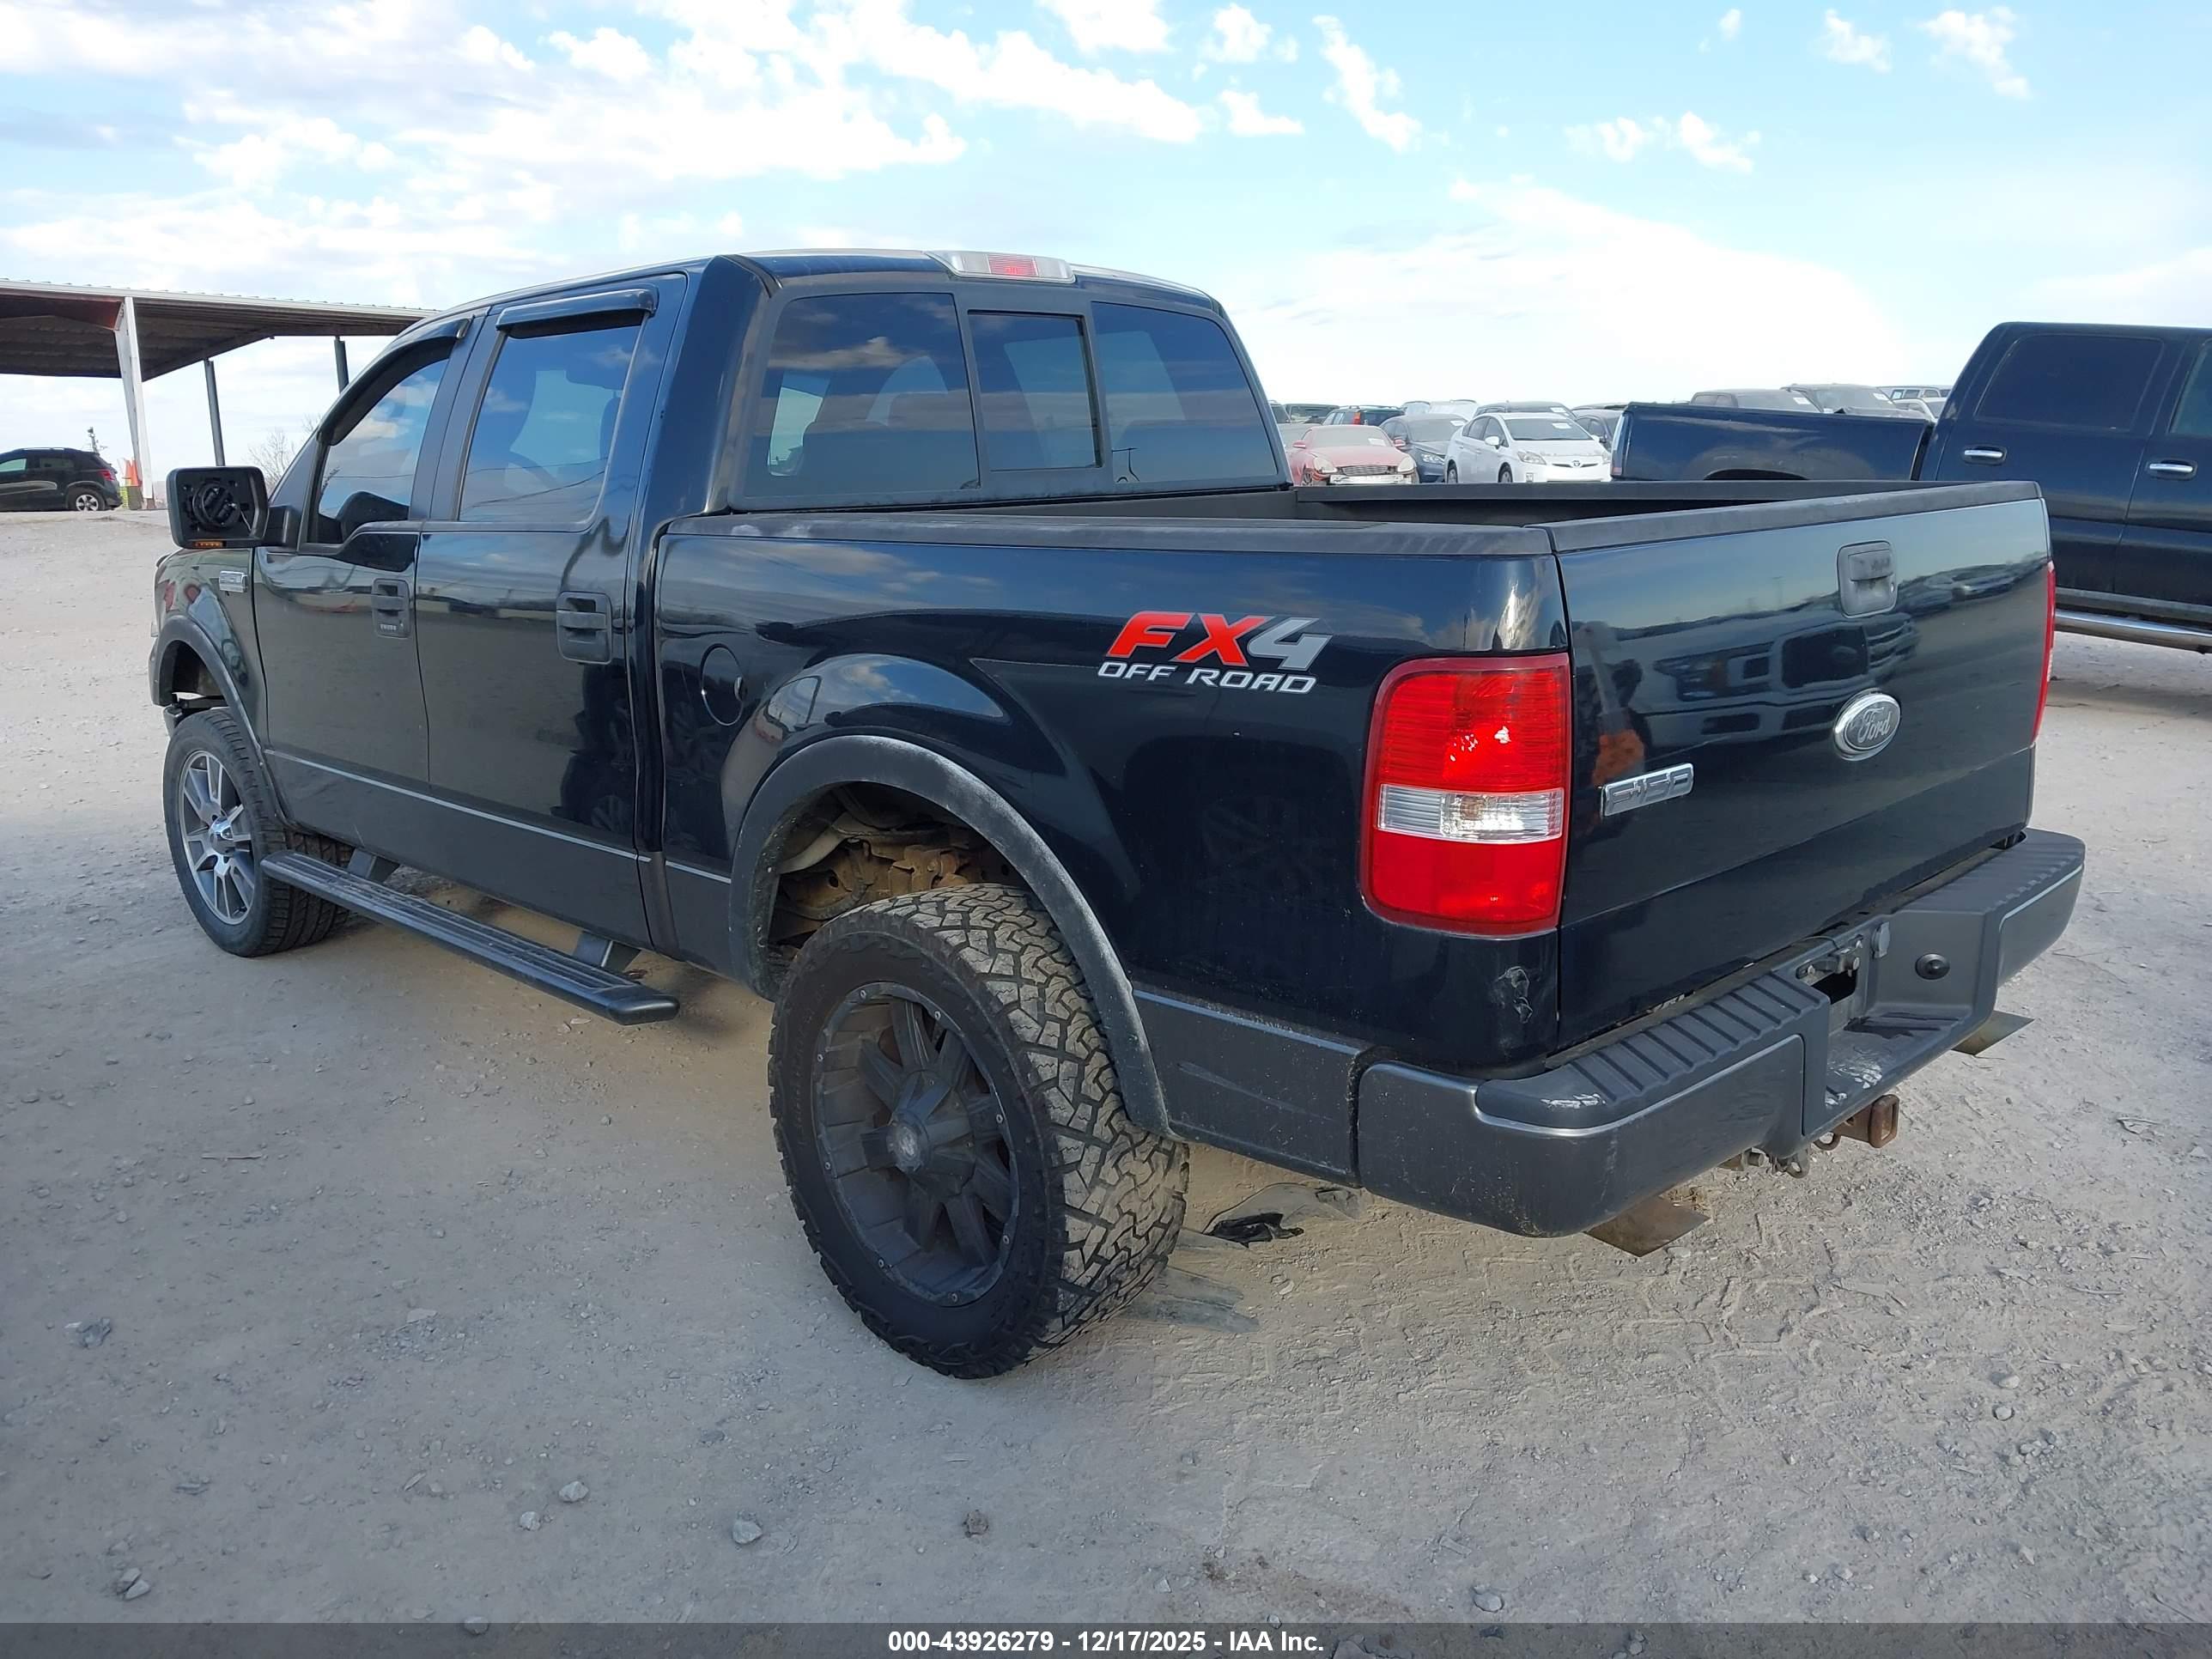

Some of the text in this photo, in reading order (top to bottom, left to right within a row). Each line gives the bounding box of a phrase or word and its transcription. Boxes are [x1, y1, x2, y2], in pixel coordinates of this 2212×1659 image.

[1105, 611, 1333, 671] FX4
[1097, 661, 1317, 694] OFF ROAD
[1852, 707, 1893, 744] Ford
